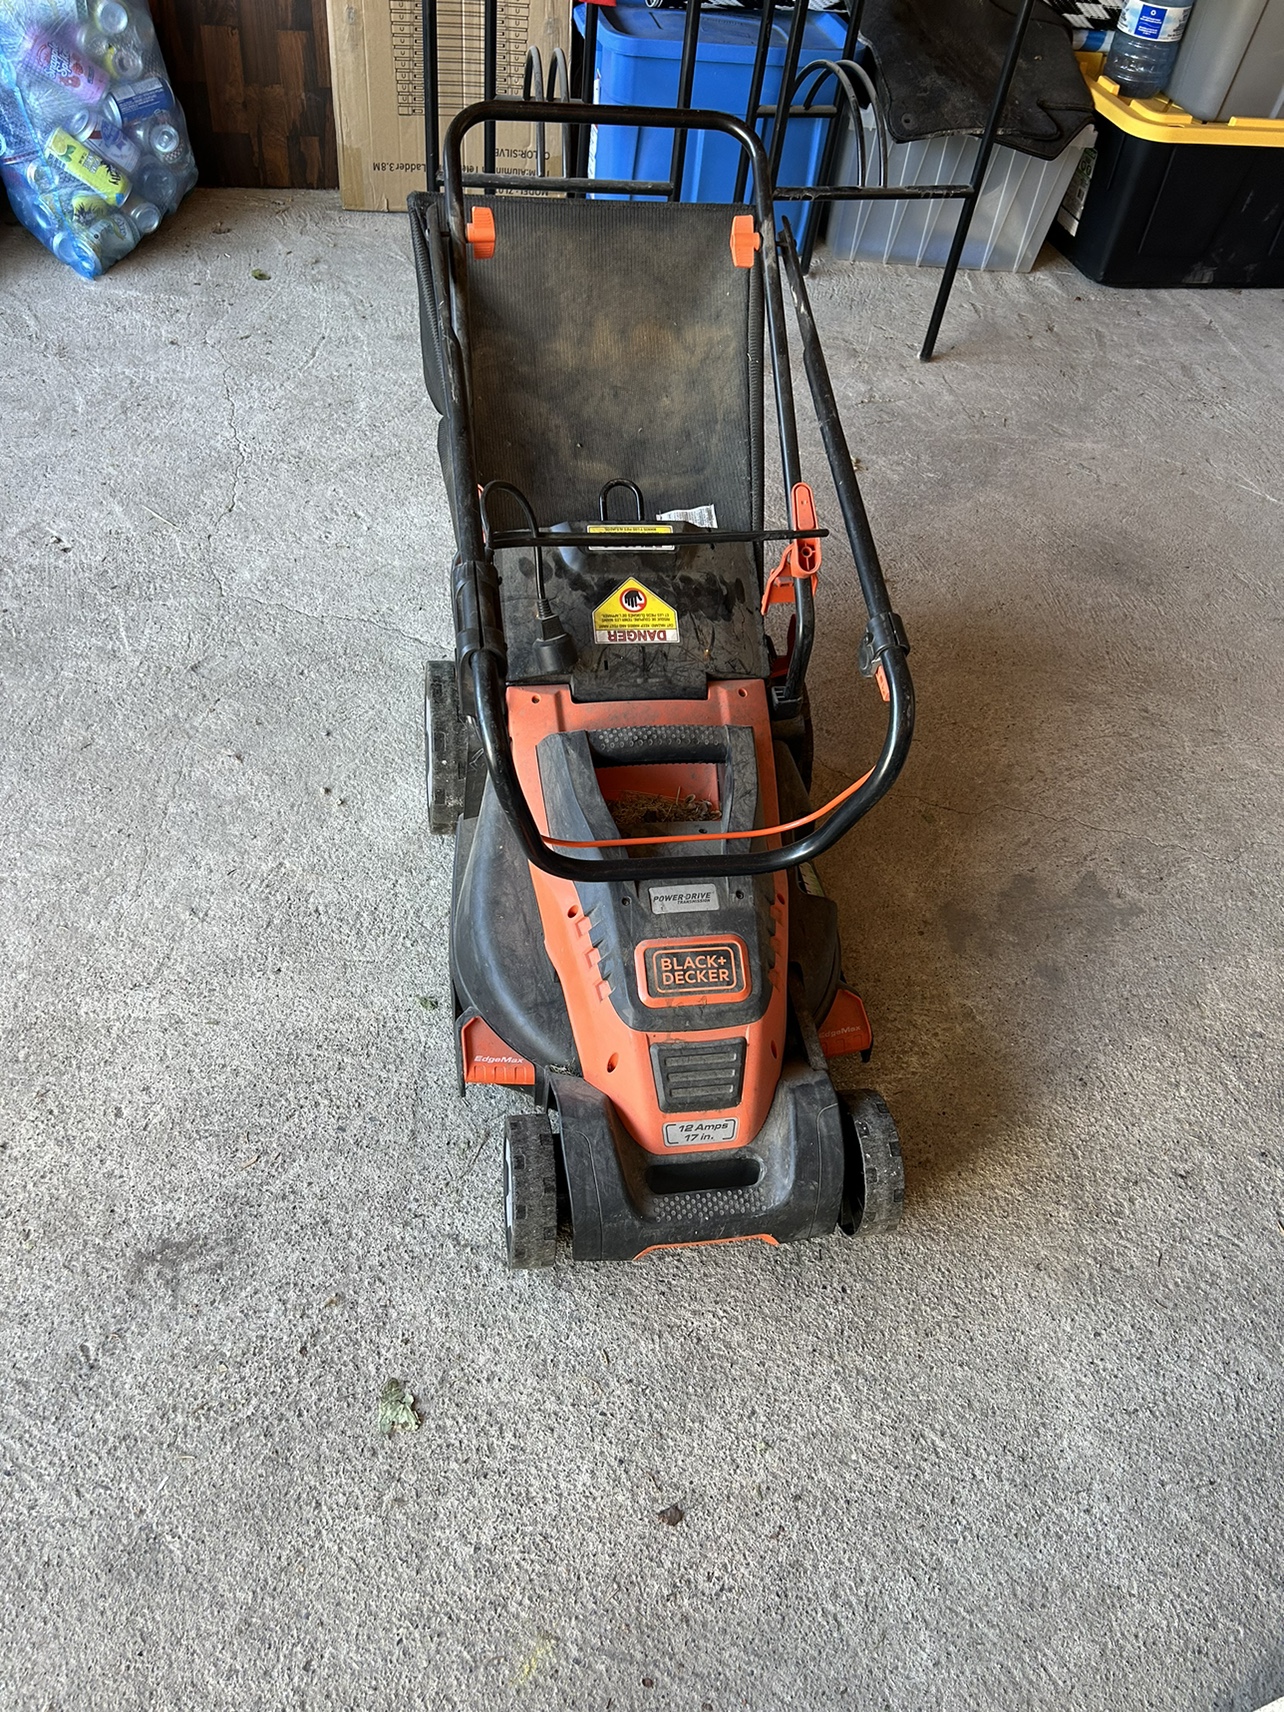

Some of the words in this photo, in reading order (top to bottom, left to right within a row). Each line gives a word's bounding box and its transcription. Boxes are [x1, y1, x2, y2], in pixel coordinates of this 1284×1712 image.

[44, 42, 61, 79] Snapple
[496, 148, 550, 160] CLOR:SILVE
[607, 629, 667, 642] DANGER
[661, 955, 727, 971] BLACK+
[662, 969, 730, 985] DECKER
[474, 1055, 523, 1064] EdgeMax
[679, 1124, 694, 1132] 12
[695, 1123, 729, 1131] Amps
[684, 1133, 699, 1142] 17
